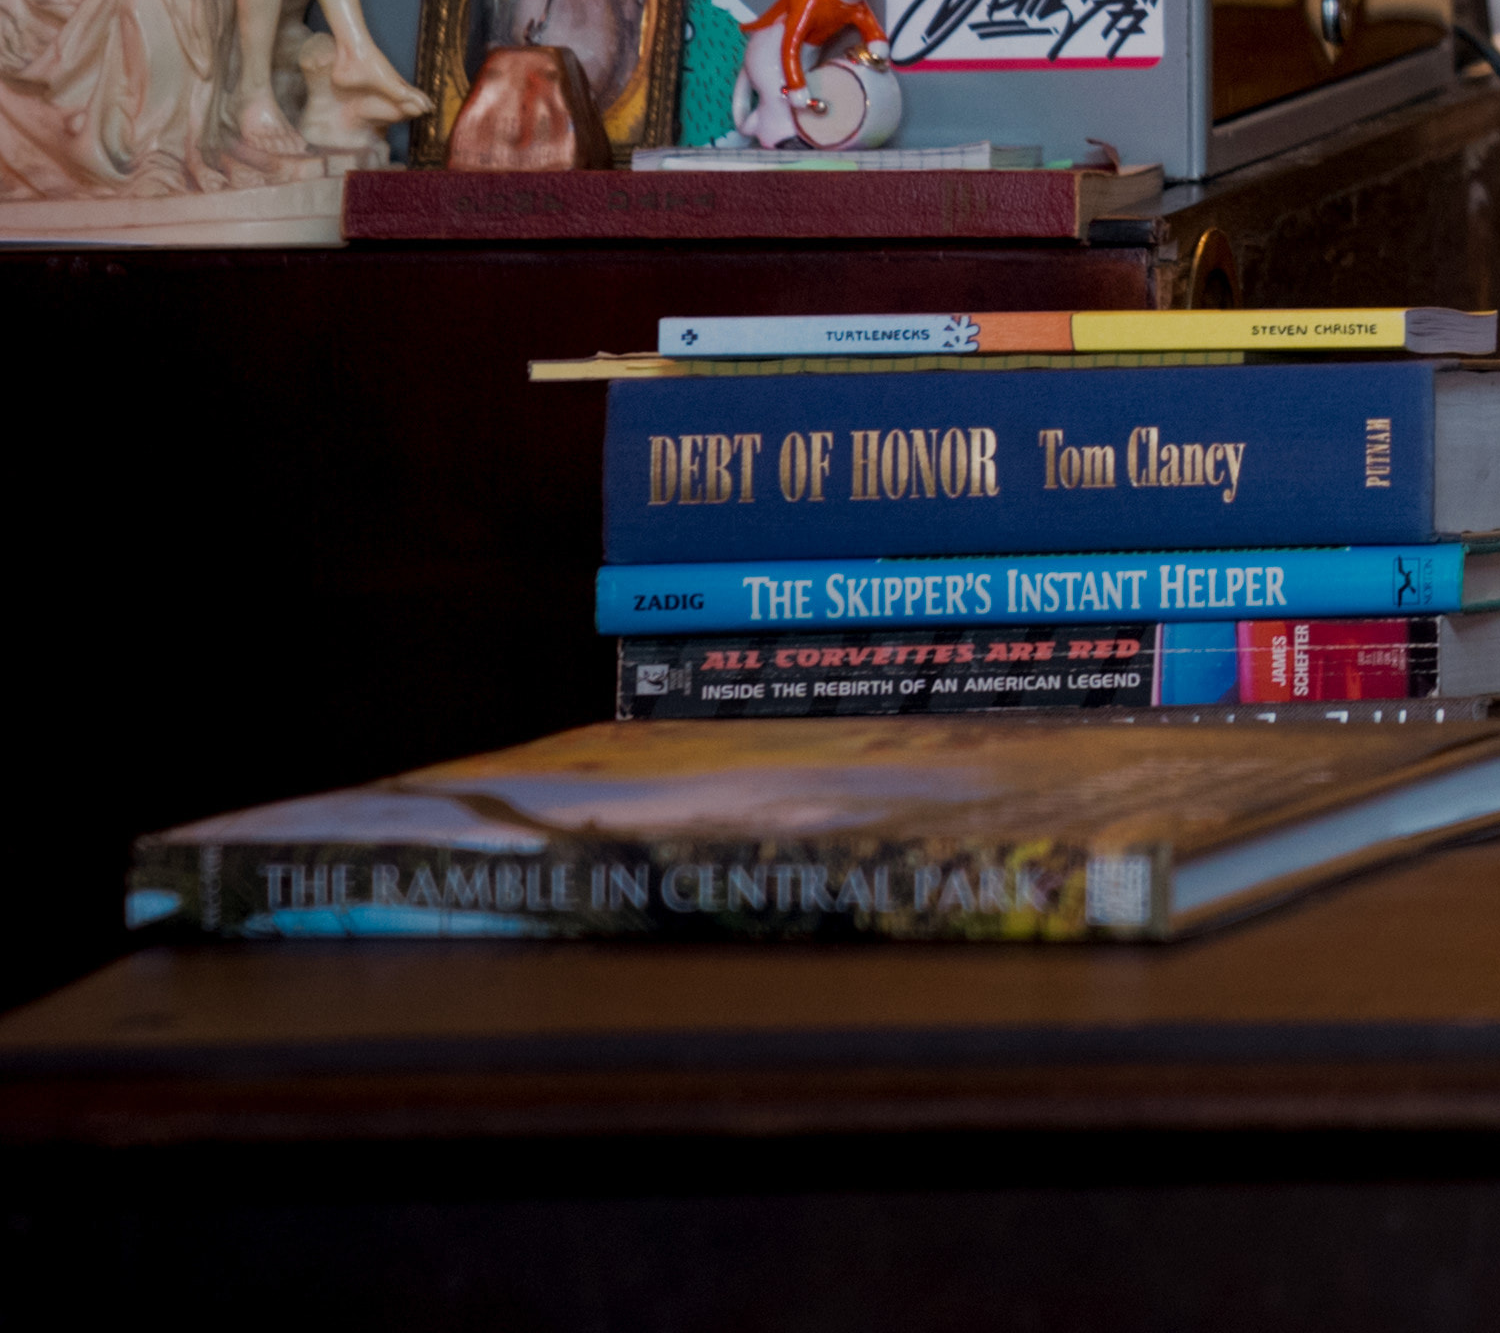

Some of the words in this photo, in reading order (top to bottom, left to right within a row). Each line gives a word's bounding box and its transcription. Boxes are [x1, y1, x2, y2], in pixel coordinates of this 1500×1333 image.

[825, 330, 931, 342] TURTLENECKS
[1251, 325, 1308, 337] STEVEN
[1315, 324, 1378, 336] CHRISTIE
[648, 434, 760, 505] DEBT
[779, 431, 833, 502] OF
[848, 427, 1000, 501] HONOR
[1038, 429, 1116, 489] Tom
[1126, 426, 1247, 503] Clancy
[1365, 418, 1391, 488] PUTNAM
[633, 594, 705, 612] ZADIG
[701, 650, 763, 671] ALL
[774, 643, 976, 670] CORVETTES
[986, 640, 1057, 663] ARE
[1068, 638, 1141, 661] RED
[1271, 634, 1288, 688] JAMES
[1293, 624, 1310, 697] SCHEFTER
[702, 684, 765, 701] INSIDE
[770, 683, 807, 699] THE
[813, 680, 893, 697] REBIRTH
[899, 679, 926, 694] OF
[930, 678, 958, 693] AN
[963, 673, 1060, 694] AMERICAN
[1066, 673, 1141, 690] LEGEND
[259, 864, 357, 909] THE
[372, 864, 574, 911] RAMBLE
[591, 865, 650, 910] IN
[659, 864, 896, 913] CENTRAL
[912, 864, 1050, 911] PARK
